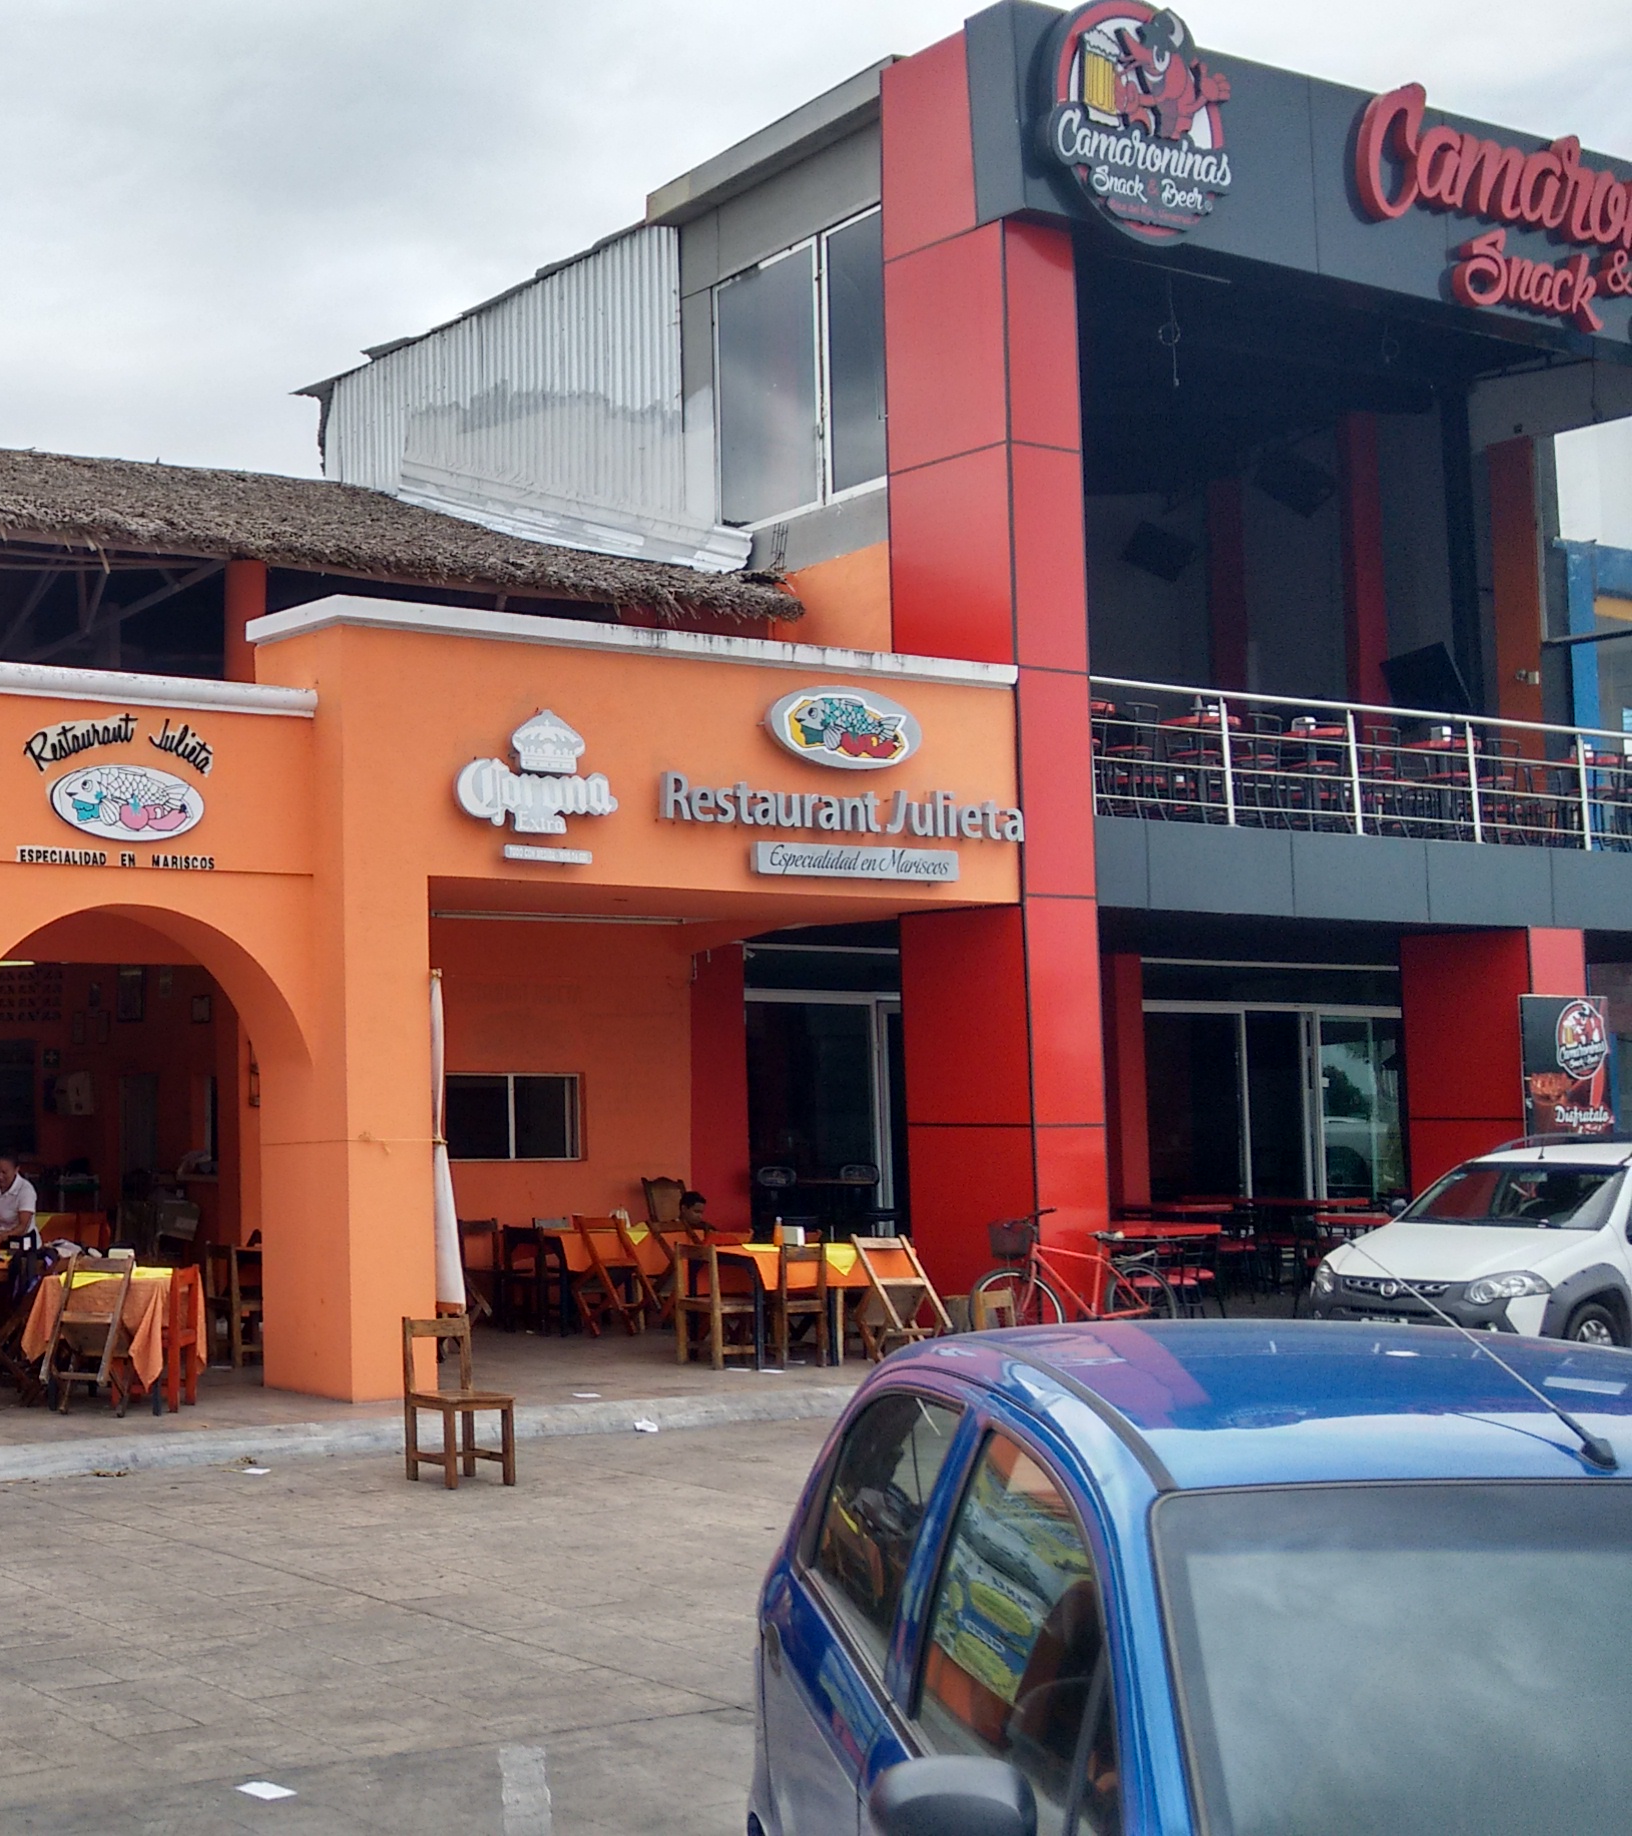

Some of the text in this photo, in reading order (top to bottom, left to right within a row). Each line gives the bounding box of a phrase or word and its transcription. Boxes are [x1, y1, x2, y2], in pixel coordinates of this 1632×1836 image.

[1058, 109, 1231, 186] Camaroninas
[1358, 83, 1632, 248] Camaro
[1092, 165, 1203, 208] Snack & Beer
[1456, 229, 1604, 333] Snack
[24, 713, 213, 774] Restaurant Julieta
[457, 758, 613, 824] Corona
[518, 811, 564, 830] Extra
[661, 771, 1024, 843] Restaurant Julieta
[19, 848, 215, 870] ESPECIALIDAD EN MARISCOS
[769, 844, 949, 876] Especialidad en Mariscos
